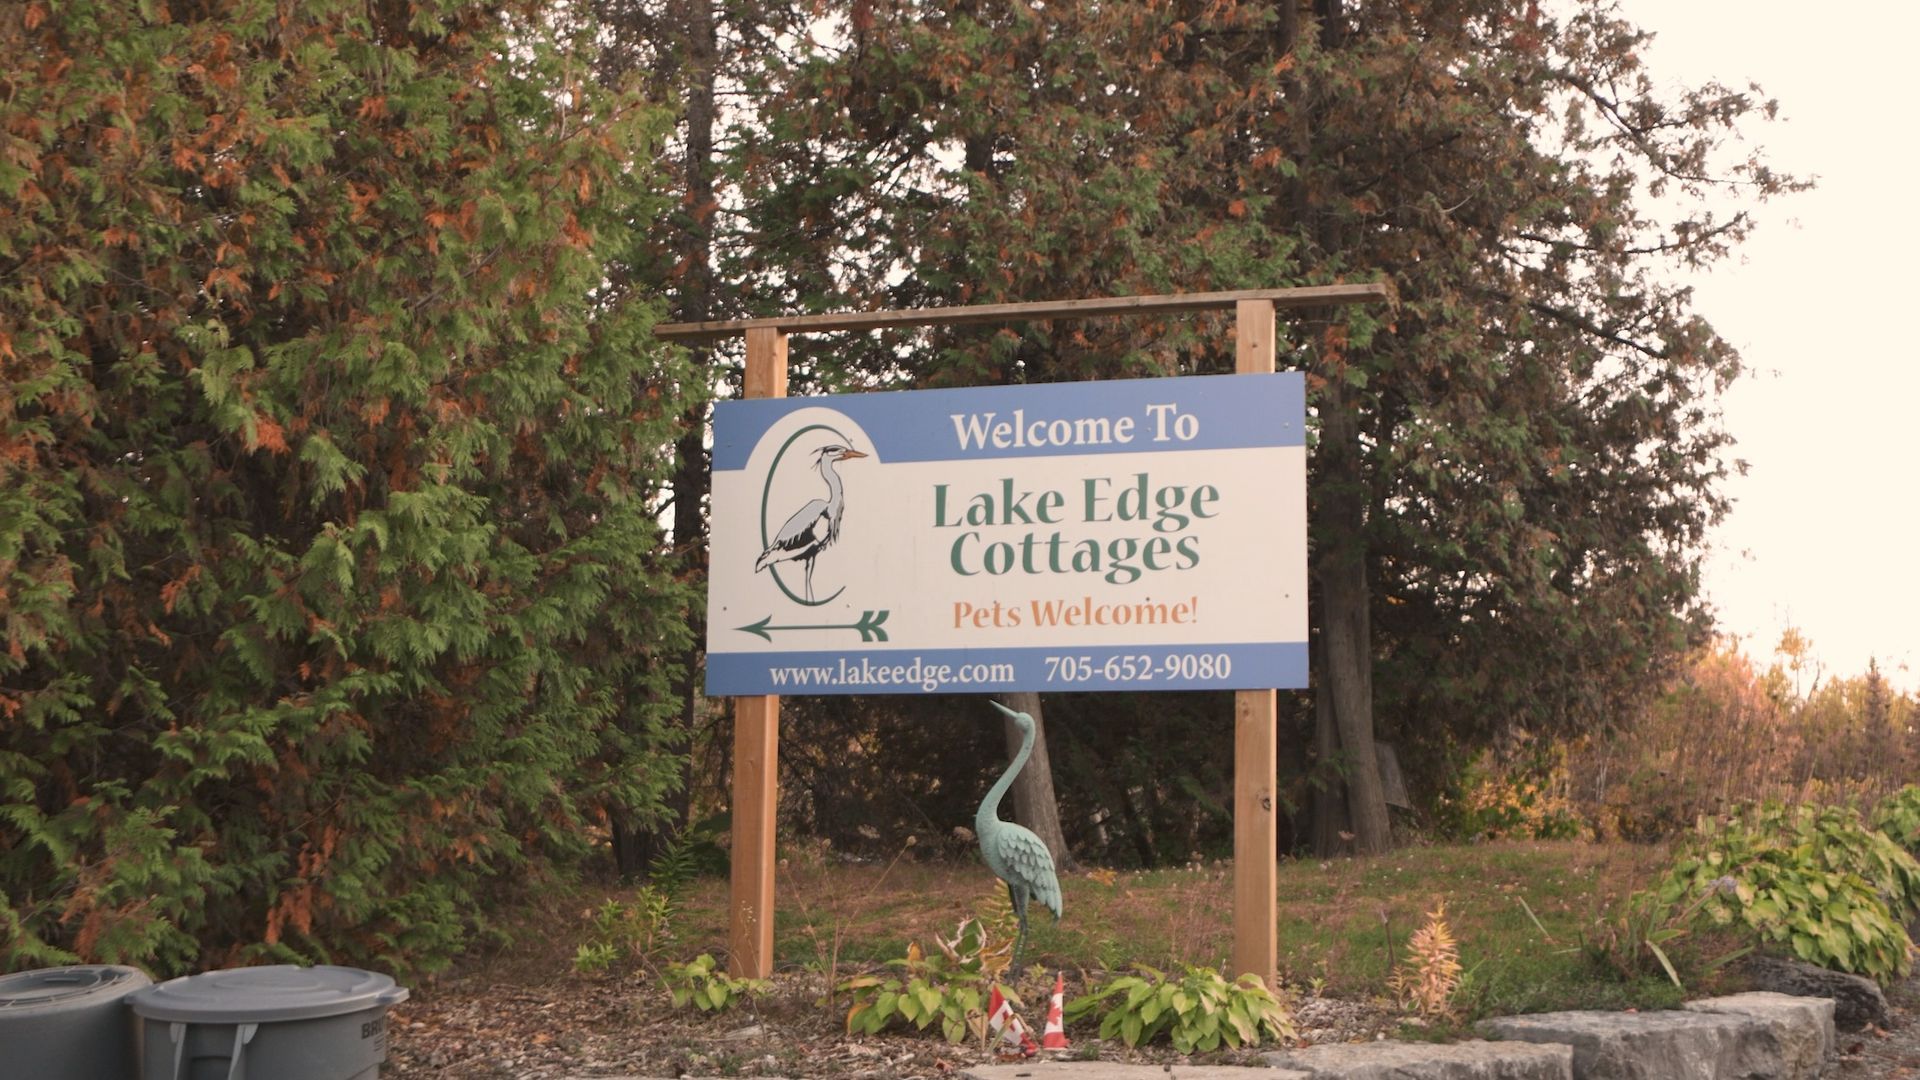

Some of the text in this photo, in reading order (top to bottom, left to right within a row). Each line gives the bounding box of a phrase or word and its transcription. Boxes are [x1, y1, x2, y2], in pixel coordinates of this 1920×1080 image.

[950, 402, 1200, 451] Welcome To
[933, 472, 1220, 533] Lake Edge
[950, 531, 1200, 585] Cottages
[954, 596, 1198, 630] Pets Welcome!
[769, 653, 1232, 692] www.lakeedge.com 705-652-9080
